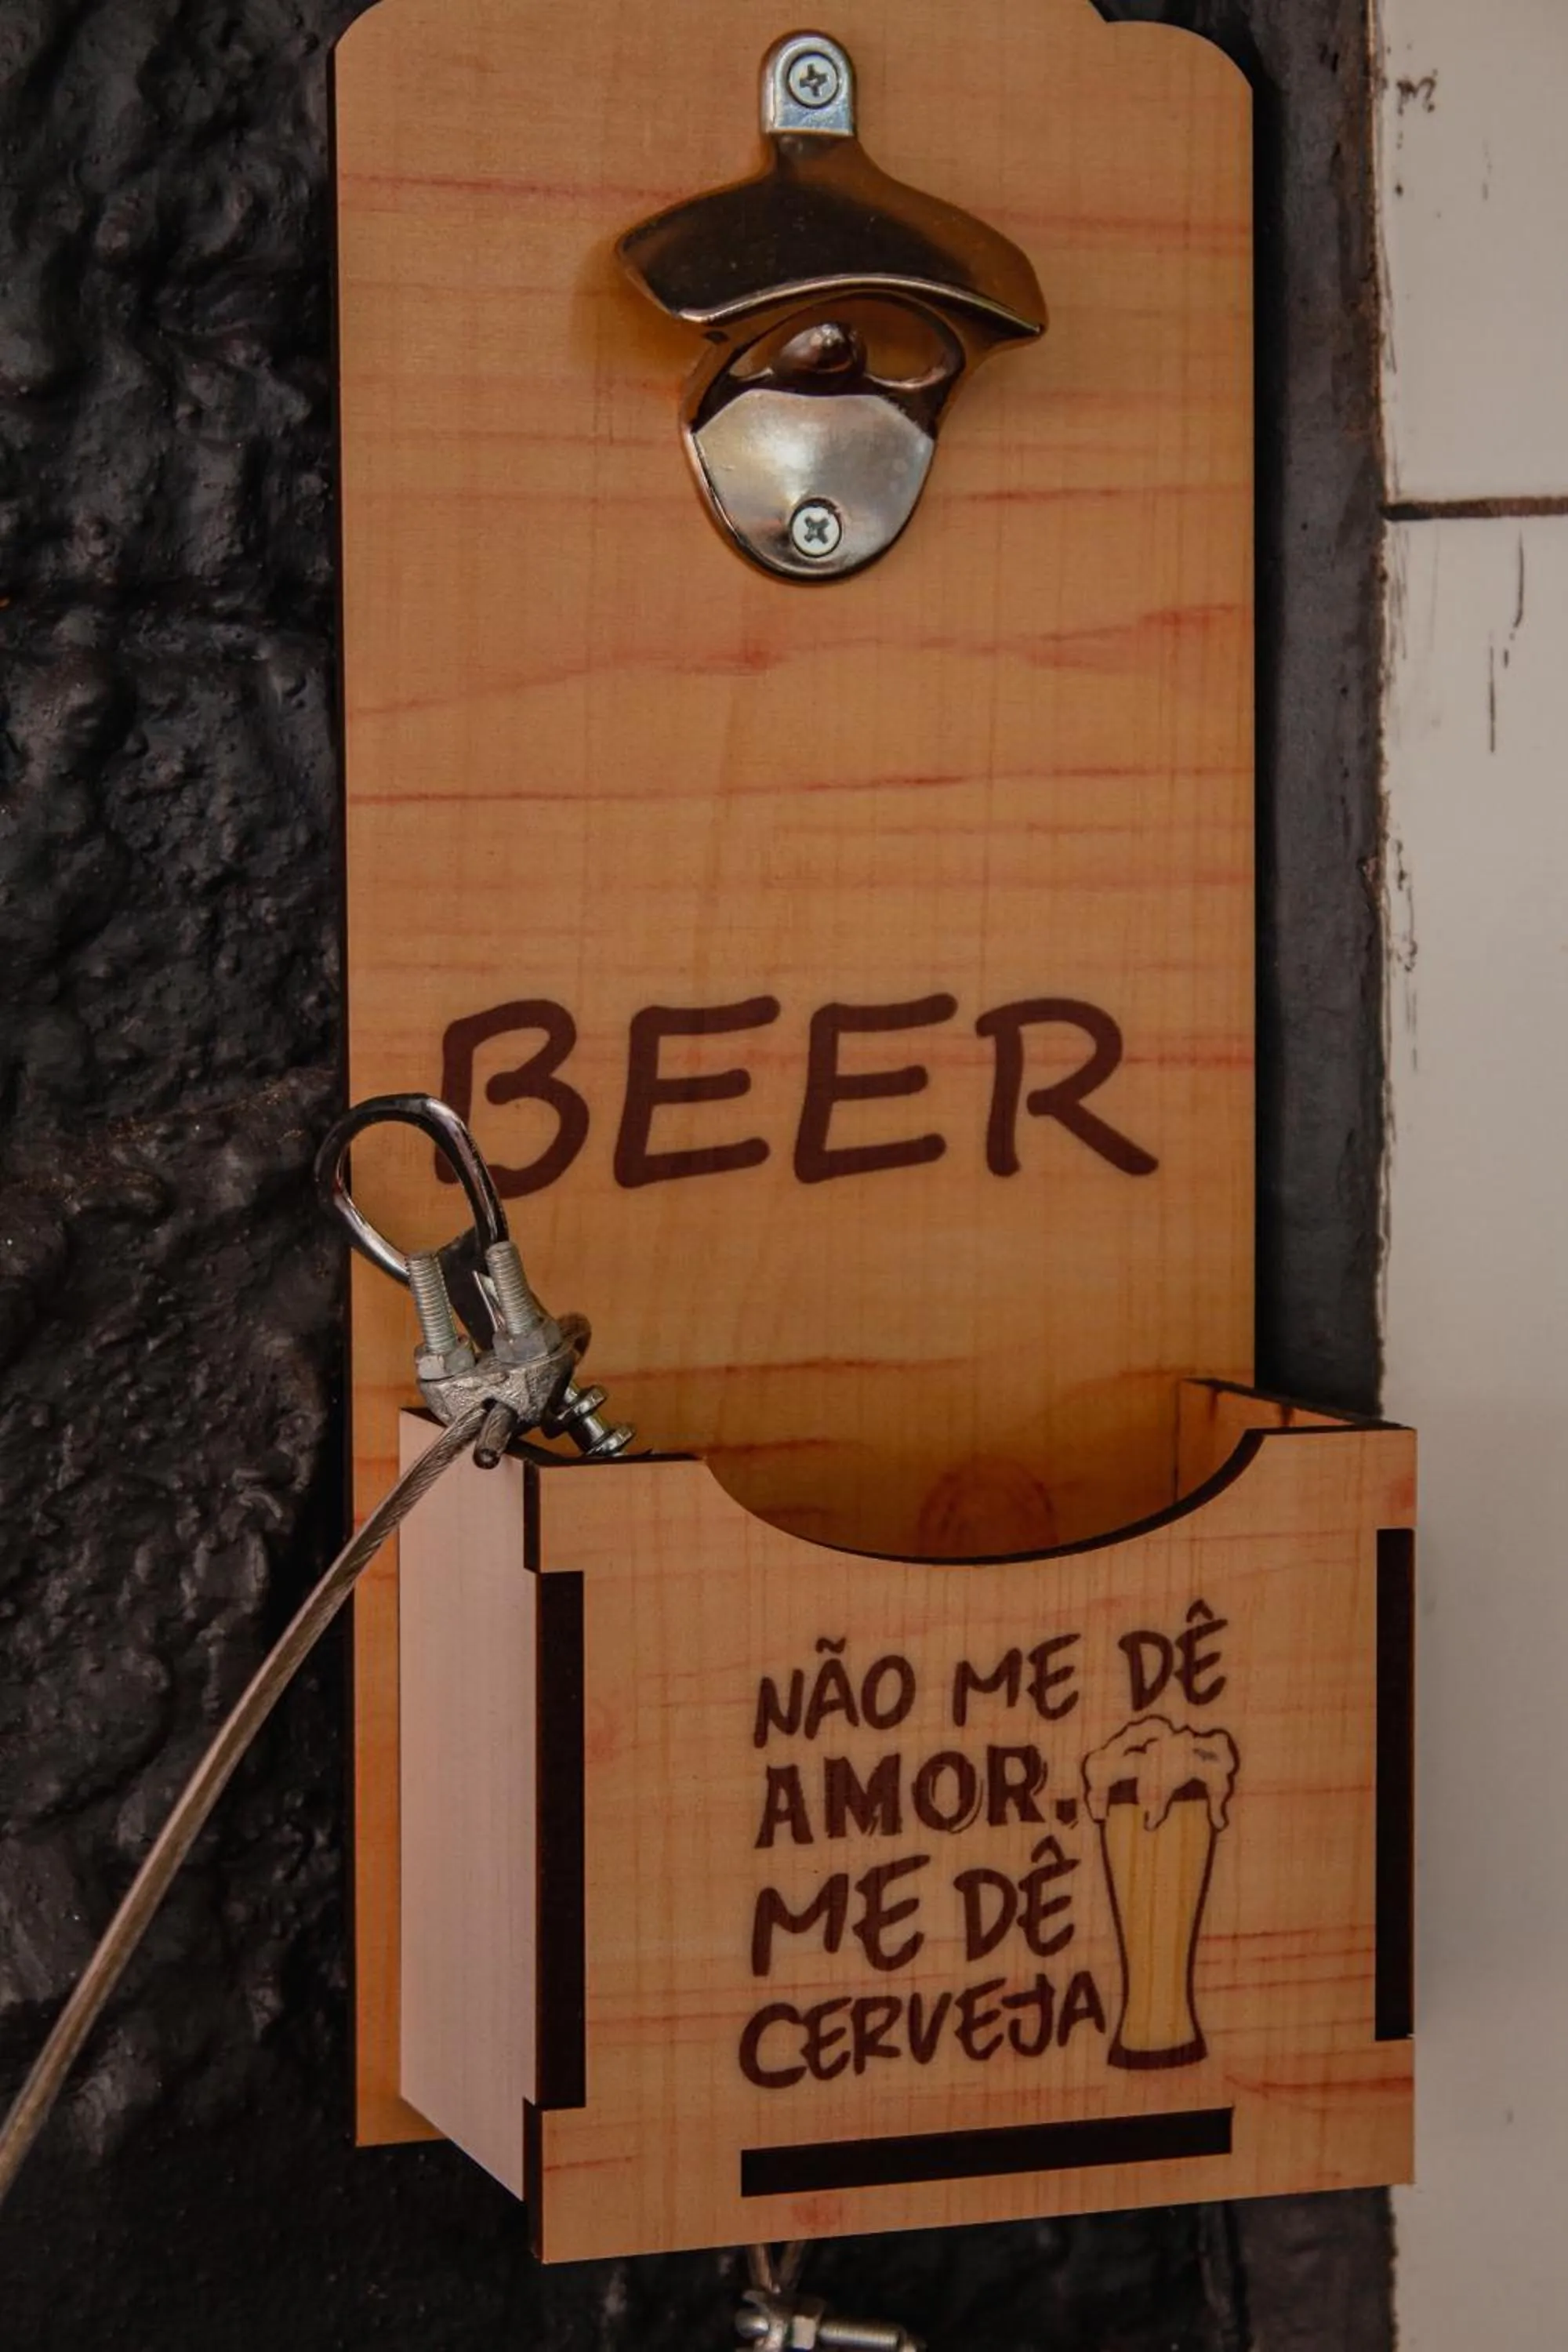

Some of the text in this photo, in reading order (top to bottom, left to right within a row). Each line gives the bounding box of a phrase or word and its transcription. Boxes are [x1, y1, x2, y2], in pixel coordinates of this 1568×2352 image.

[432, 993, 1159, 1200] BEER
[753, 1599, 1229, 1748] NÃO ME DÊ
[753, 1744, 1078, 1849] AMOR.
[751, 1835, 1081, 1976] ME DÊ
[738, 1970, 1106, 2089] CERVEJA
